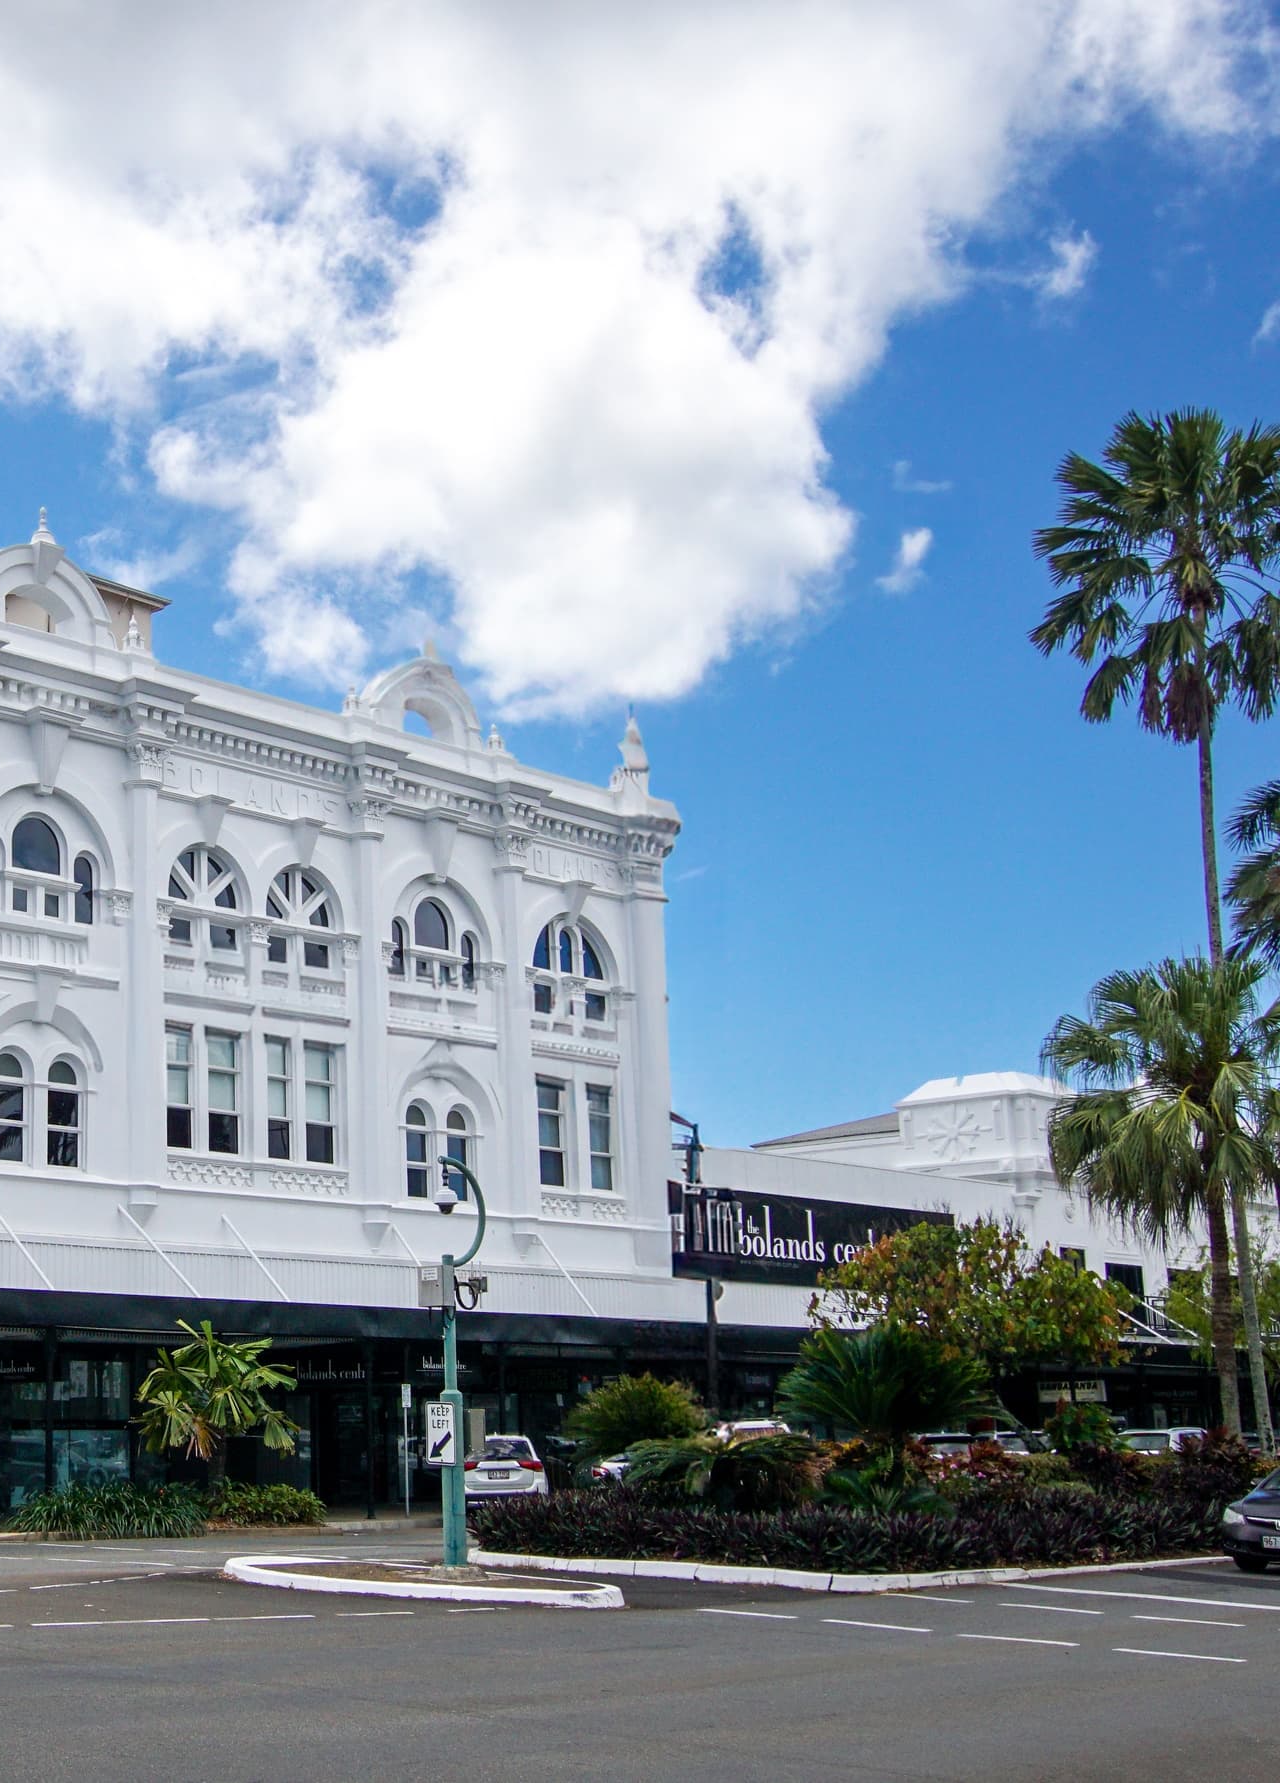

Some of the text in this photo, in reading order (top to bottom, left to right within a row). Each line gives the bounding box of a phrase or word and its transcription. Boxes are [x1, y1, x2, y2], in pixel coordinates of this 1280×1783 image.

[747, 1215, 760, 1235] the
[737, 1204, 826, 1262] bolands
[430, 1406, 450, 1416] KEEP
[431, 1419, 449, 1429] LEFT
